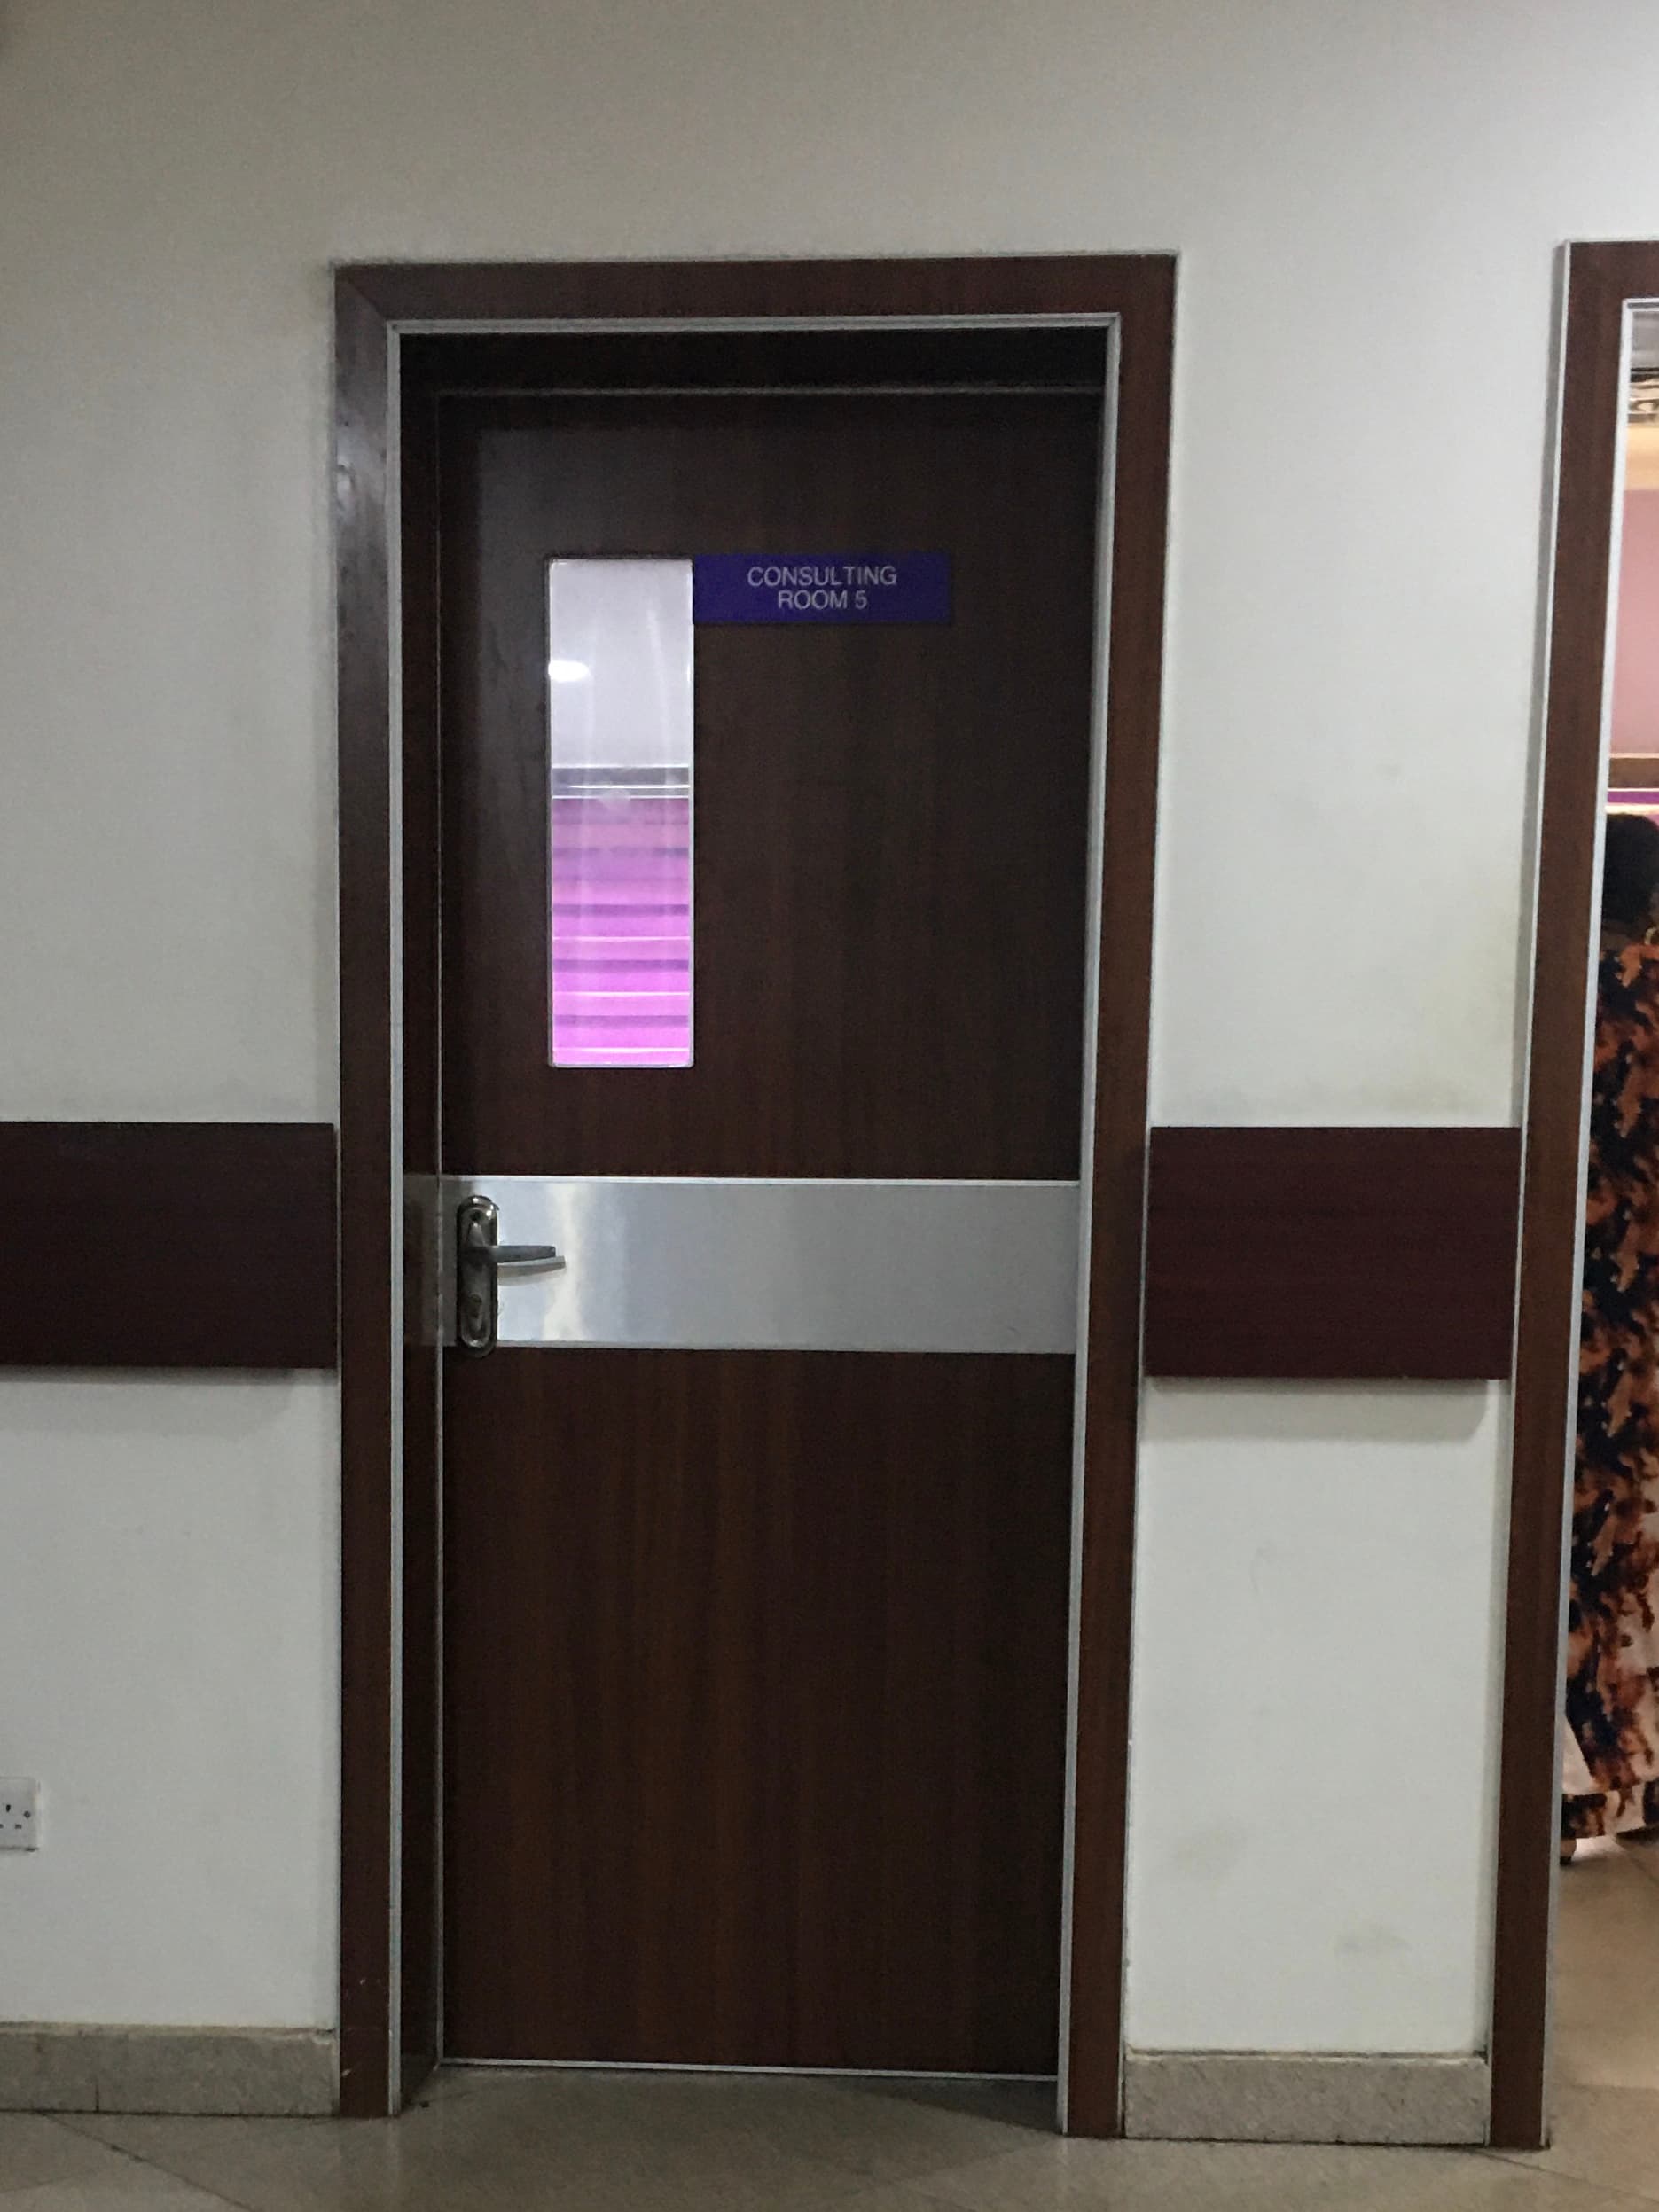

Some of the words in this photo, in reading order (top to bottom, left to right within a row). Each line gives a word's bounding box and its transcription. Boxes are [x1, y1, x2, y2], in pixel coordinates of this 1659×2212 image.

[747, 566, 897, 587] CONSULTING
[778, 590, 848, 609] ROOM
[855, 590, 868, 609] 5
